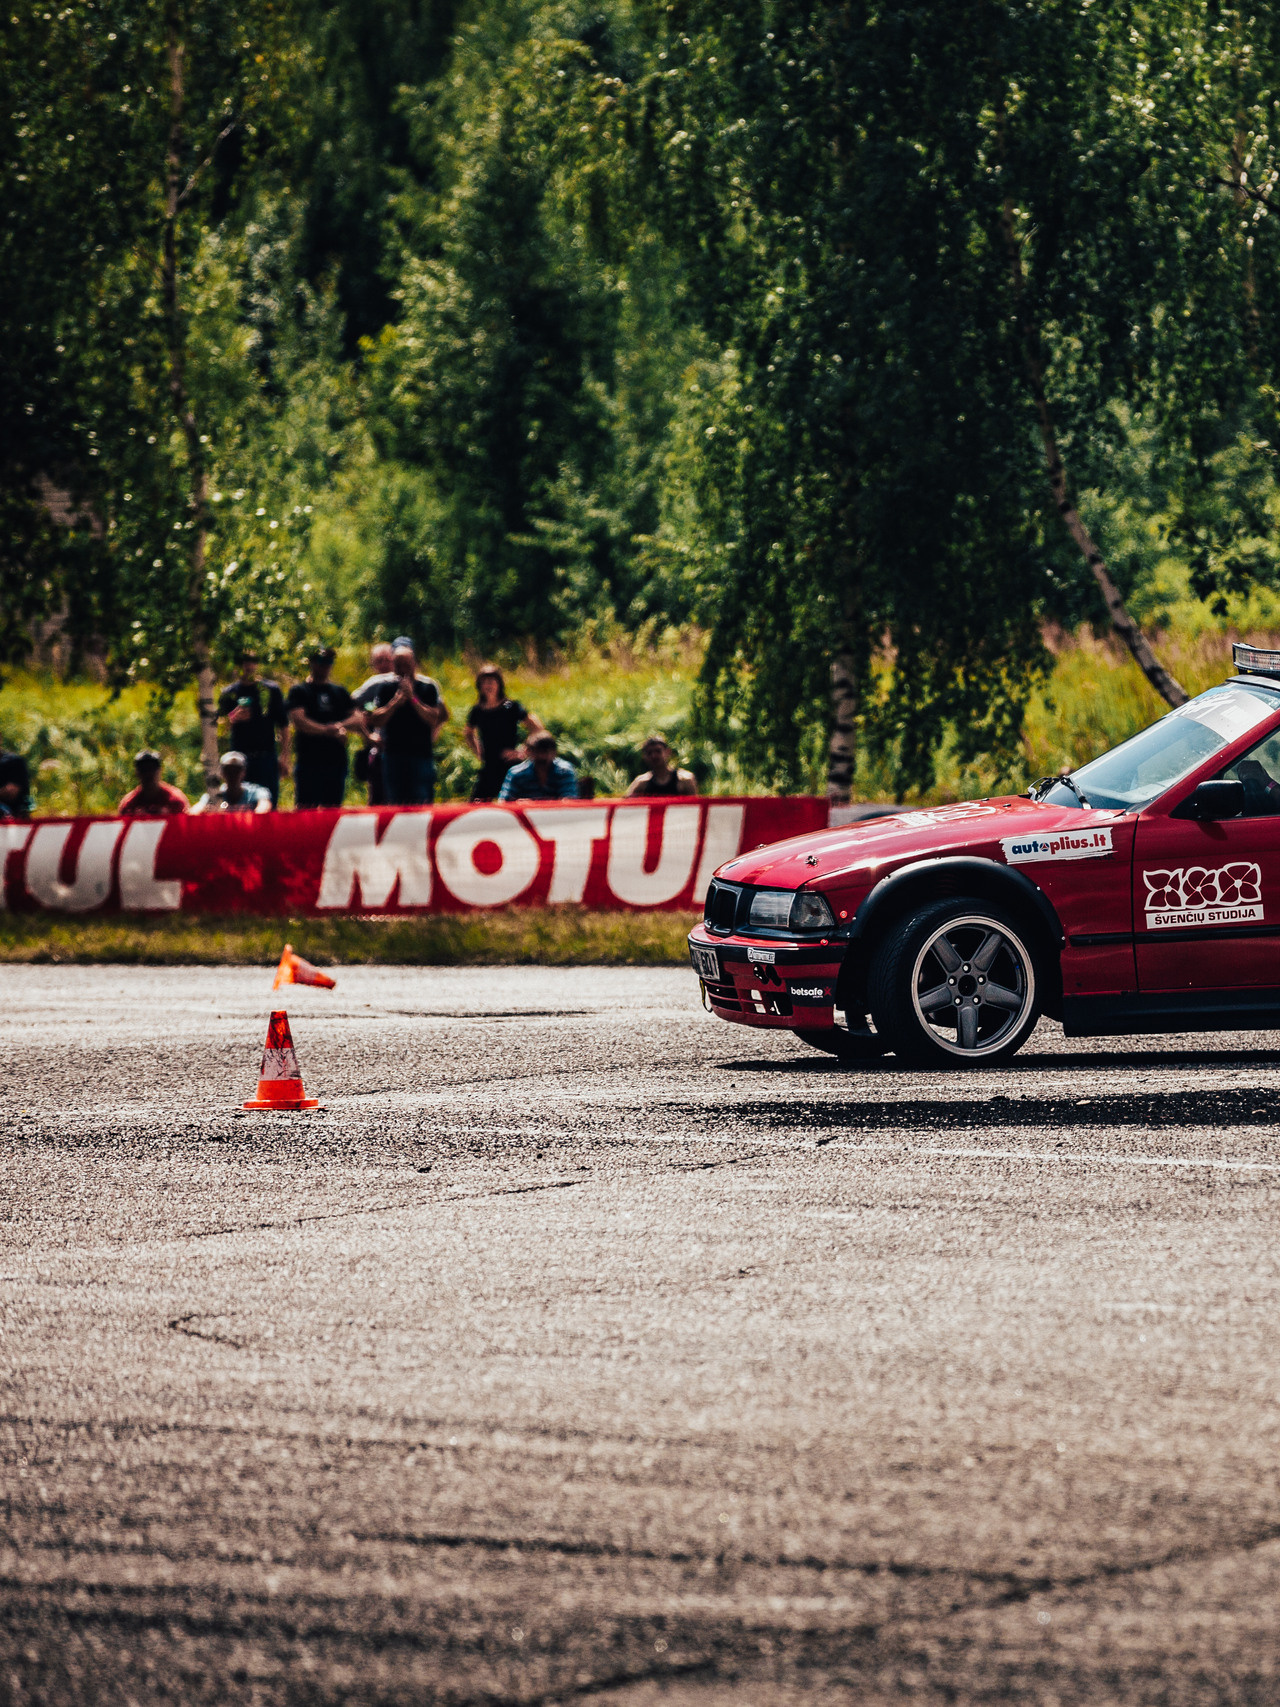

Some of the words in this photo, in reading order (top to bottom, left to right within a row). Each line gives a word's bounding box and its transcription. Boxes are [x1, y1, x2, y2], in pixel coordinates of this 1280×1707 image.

[1154, 912, 1205, 925] ŠVENČIŲ
[1208, 908, 1256, 921] STUDIJA
[790, 986, 824, 996] betsafe
